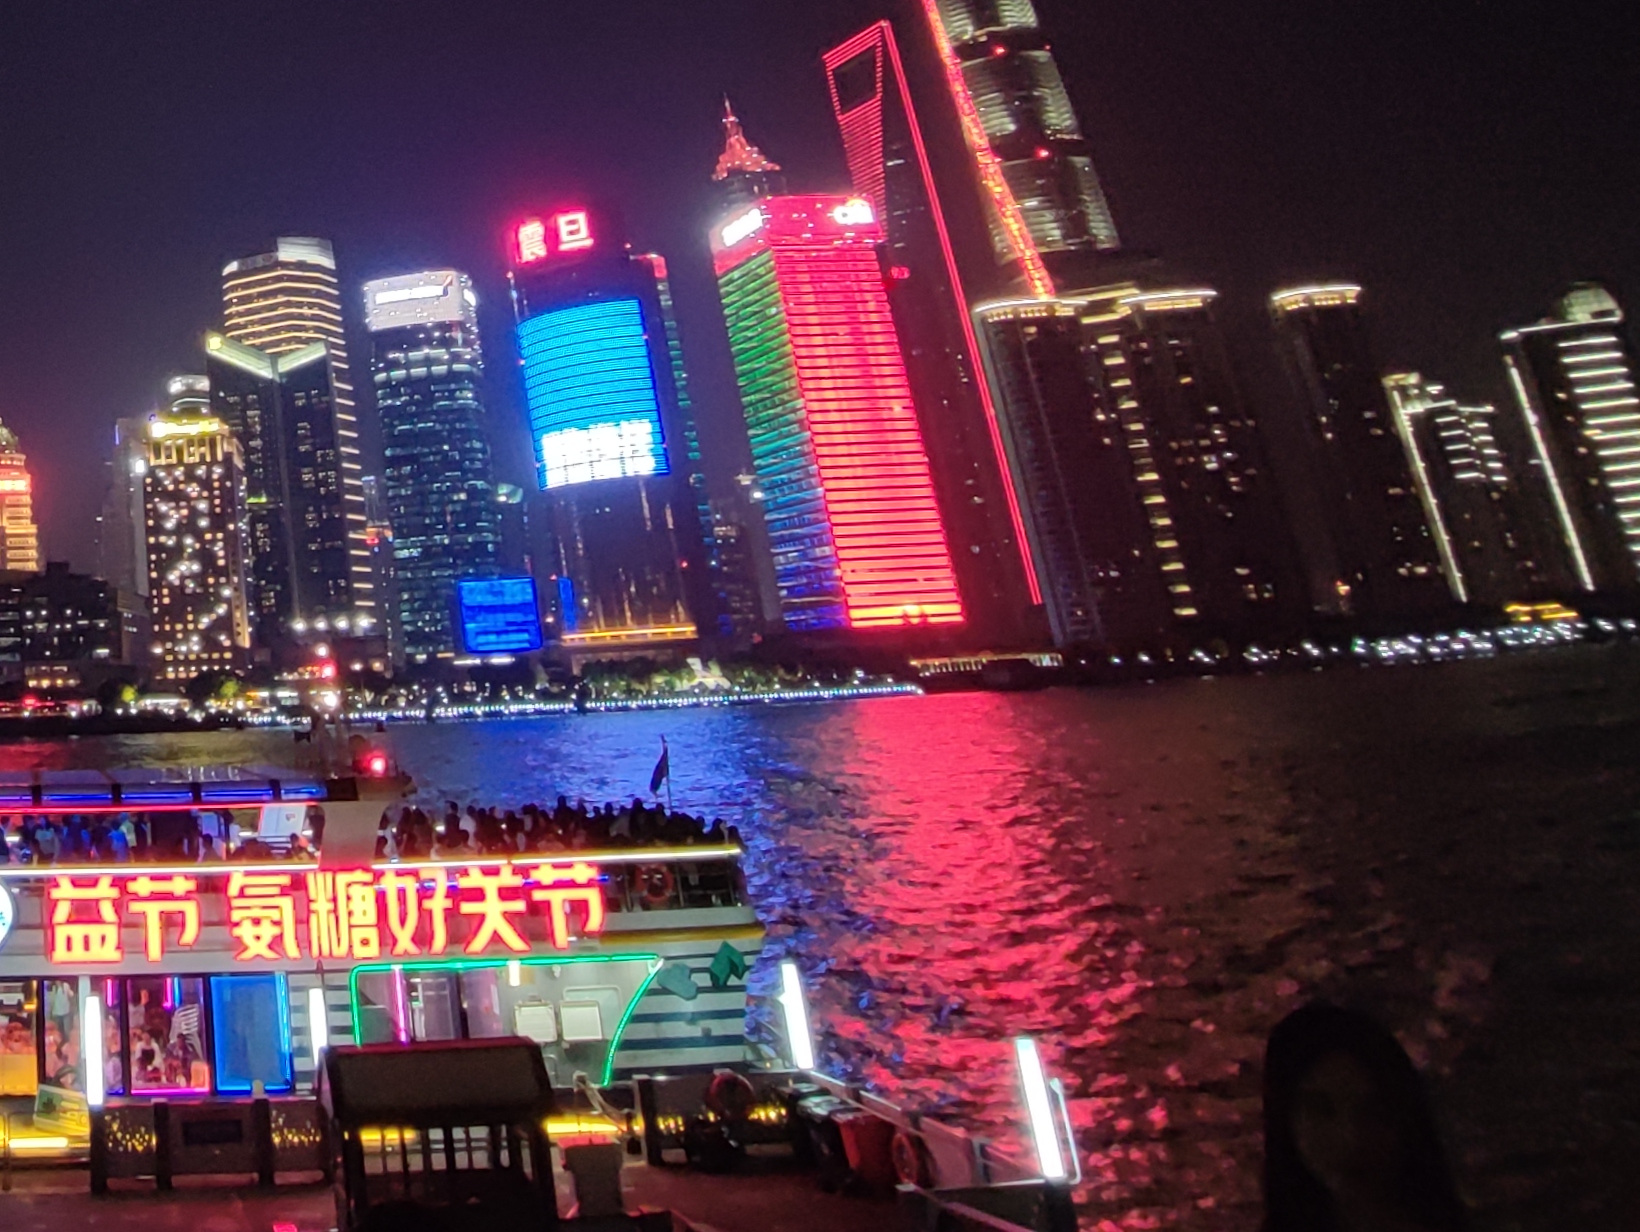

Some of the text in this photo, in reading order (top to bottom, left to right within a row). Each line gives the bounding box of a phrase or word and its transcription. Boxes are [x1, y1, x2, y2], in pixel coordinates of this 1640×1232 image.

[517, 211, 594, 264] 震旦
[48, 862, 605, 963] 益节 氨糖好关节
